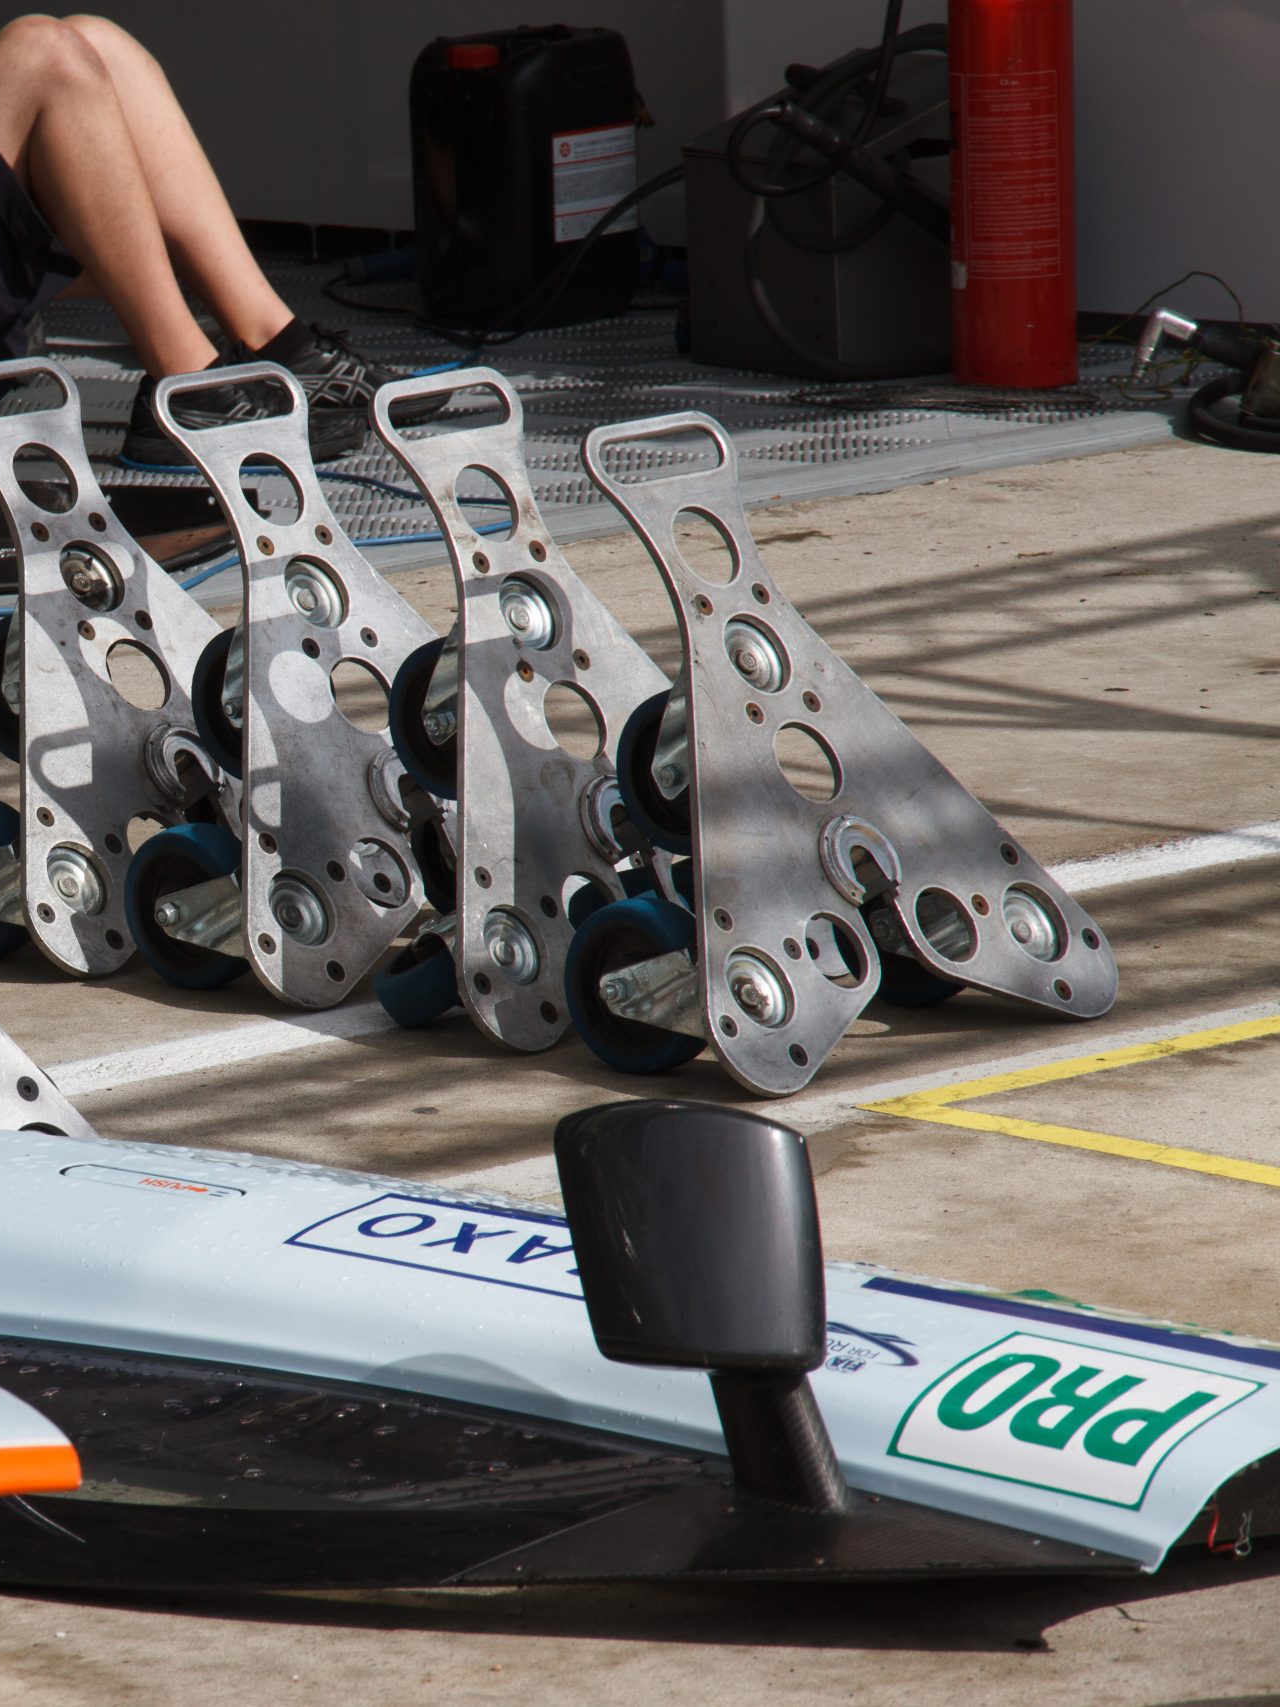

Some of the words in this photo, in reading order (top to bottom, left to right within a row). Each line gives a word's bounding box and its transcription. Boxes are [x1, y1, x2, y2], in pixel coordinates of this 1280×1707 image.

[138, 1178, 190, 1191] PUSH
[357, 1212, 578, 1277] AXO
[850, 1347, 880, 1359] FOR
[831, 1357, 864, 1371] FIA
[937, 1354, 1219, 1466] PRO
